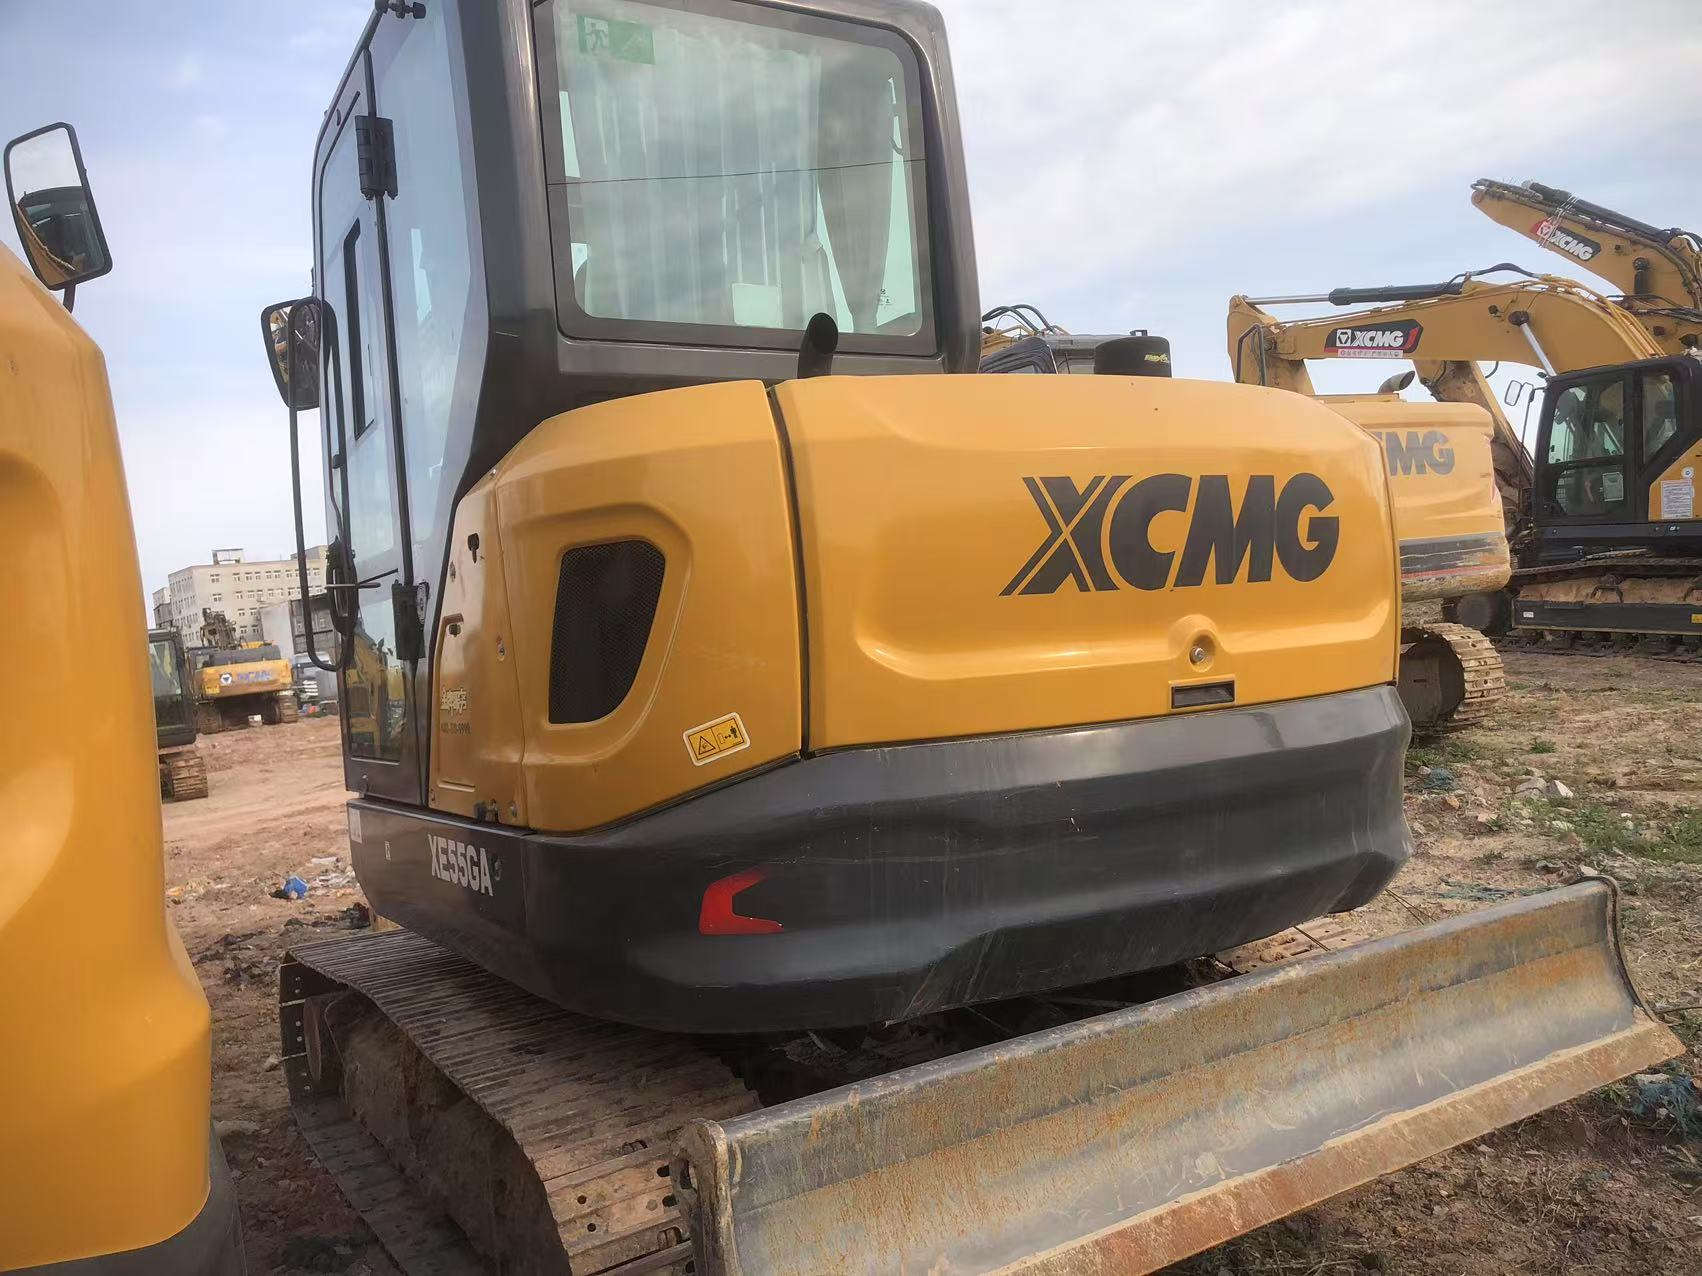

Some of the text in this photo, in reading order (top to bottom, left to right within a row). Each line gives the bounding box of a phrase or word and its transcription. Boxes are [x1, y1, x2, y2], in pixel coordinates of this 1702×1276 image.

[1548, 229, 1594, 260] XCMG
[1351, 330, 1404, 347] XCMG
[1375, 430, 1456, 476] MG
[998, 472, 1340, 597] XCMG
[427, 833, 494, 897] XE55GA
